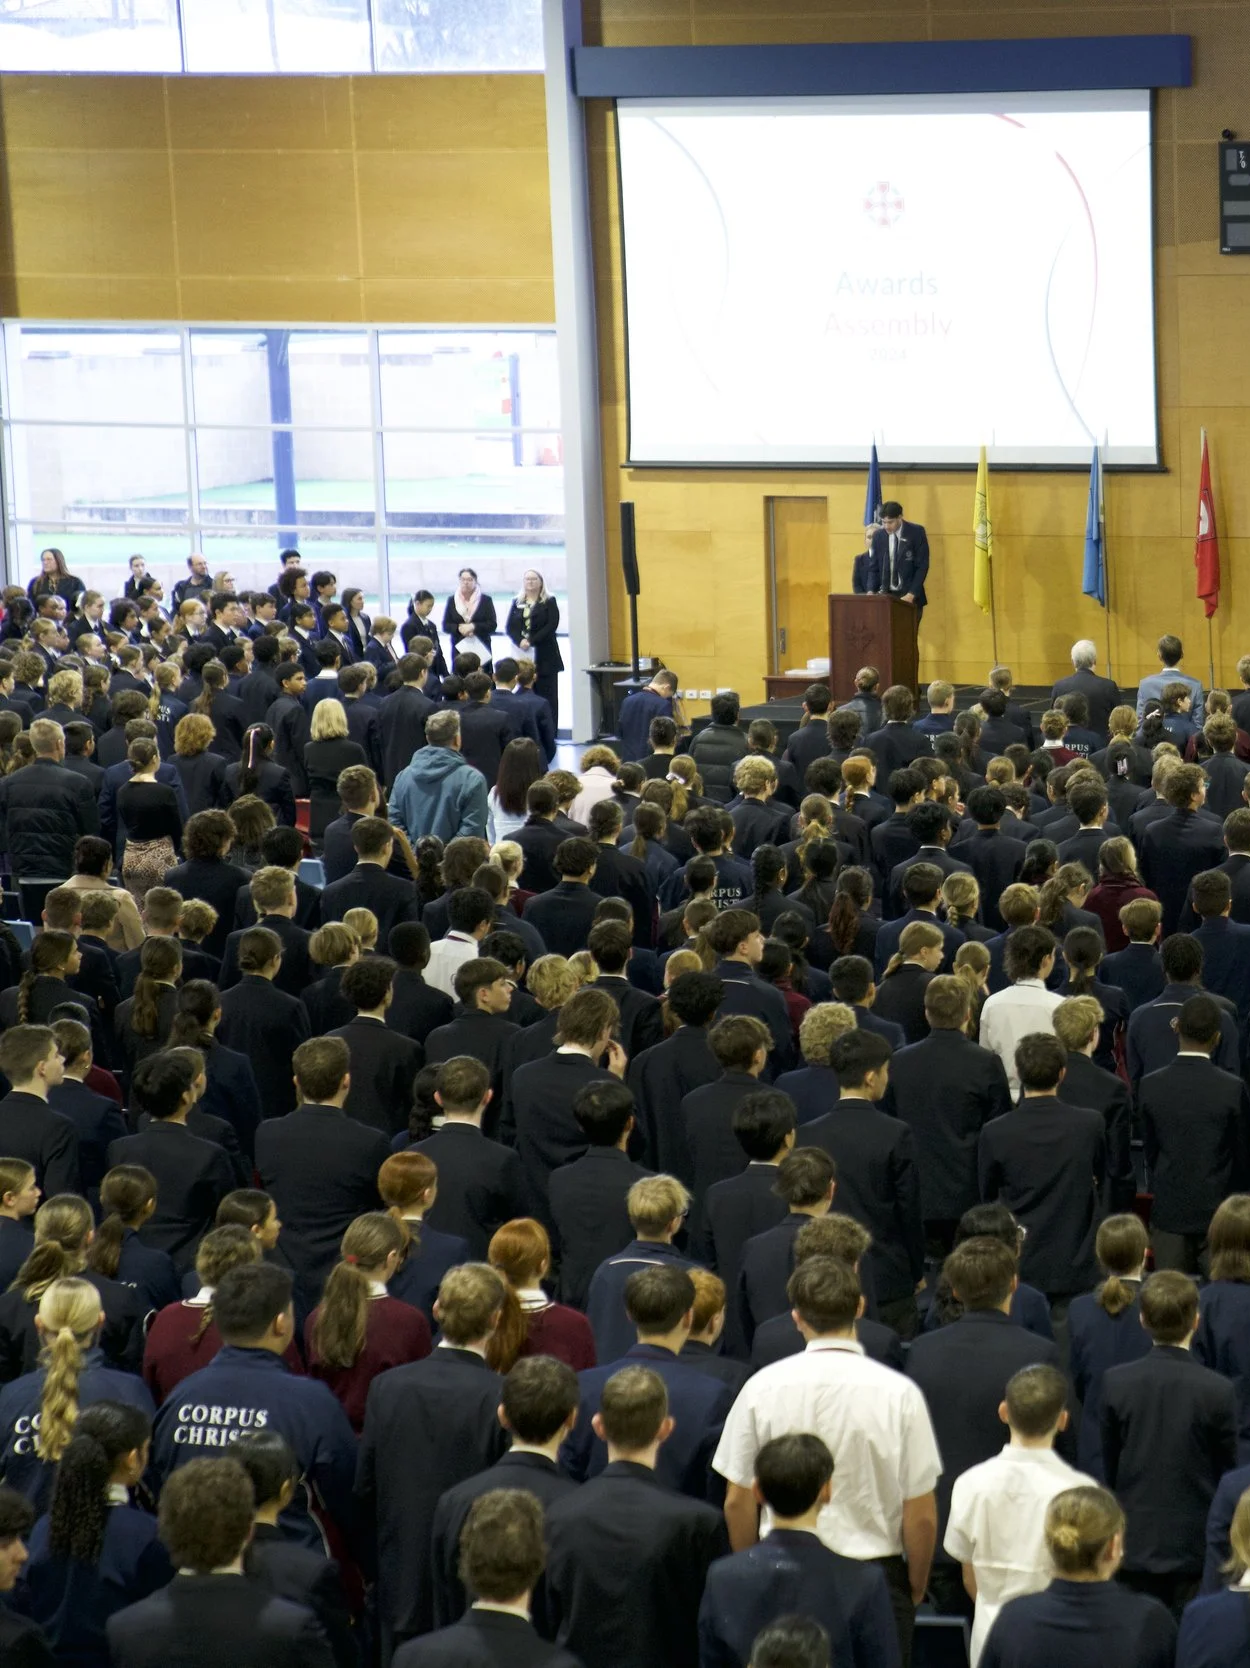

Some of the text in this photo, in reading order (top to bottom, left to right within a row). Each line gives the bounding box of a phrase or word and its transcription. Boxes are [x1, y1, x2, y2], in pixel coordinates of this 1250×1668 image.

[835, 270, 939, 296] Awards
[823, 311, 953, 343] Assembly
[711, 887, 742, 898] RPUS
[178, 1403, 269, 1428] CORPUS
[173, 1424, 251, 1447] CHRIS
